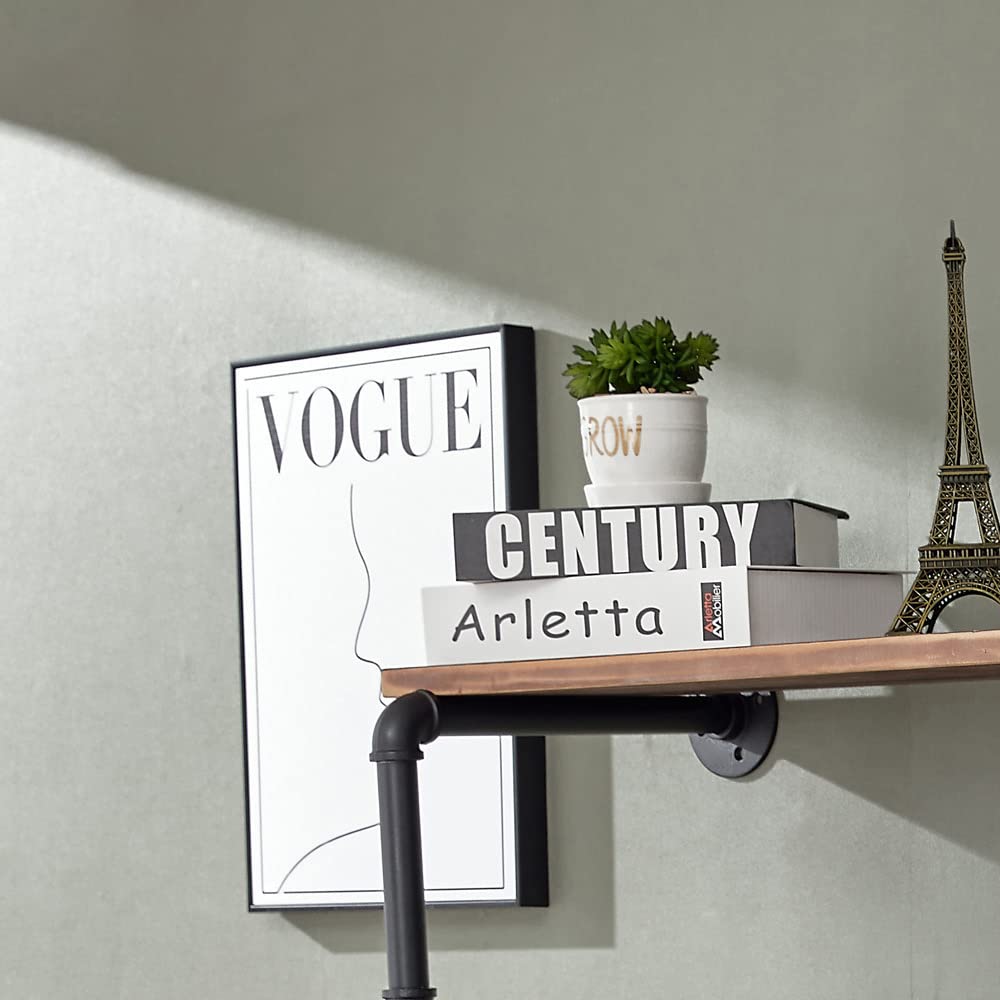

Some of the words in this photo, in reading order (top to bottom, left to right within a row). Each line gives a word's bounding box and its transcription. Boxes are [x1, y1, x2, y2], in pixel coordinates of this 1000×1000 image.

[256, 368, 482, 474] VOGUE
[485, 502, 760, 580] CENTURY
[452, 598, 664, 642] Arletta
[704, 592, 714, 633] Arletta
